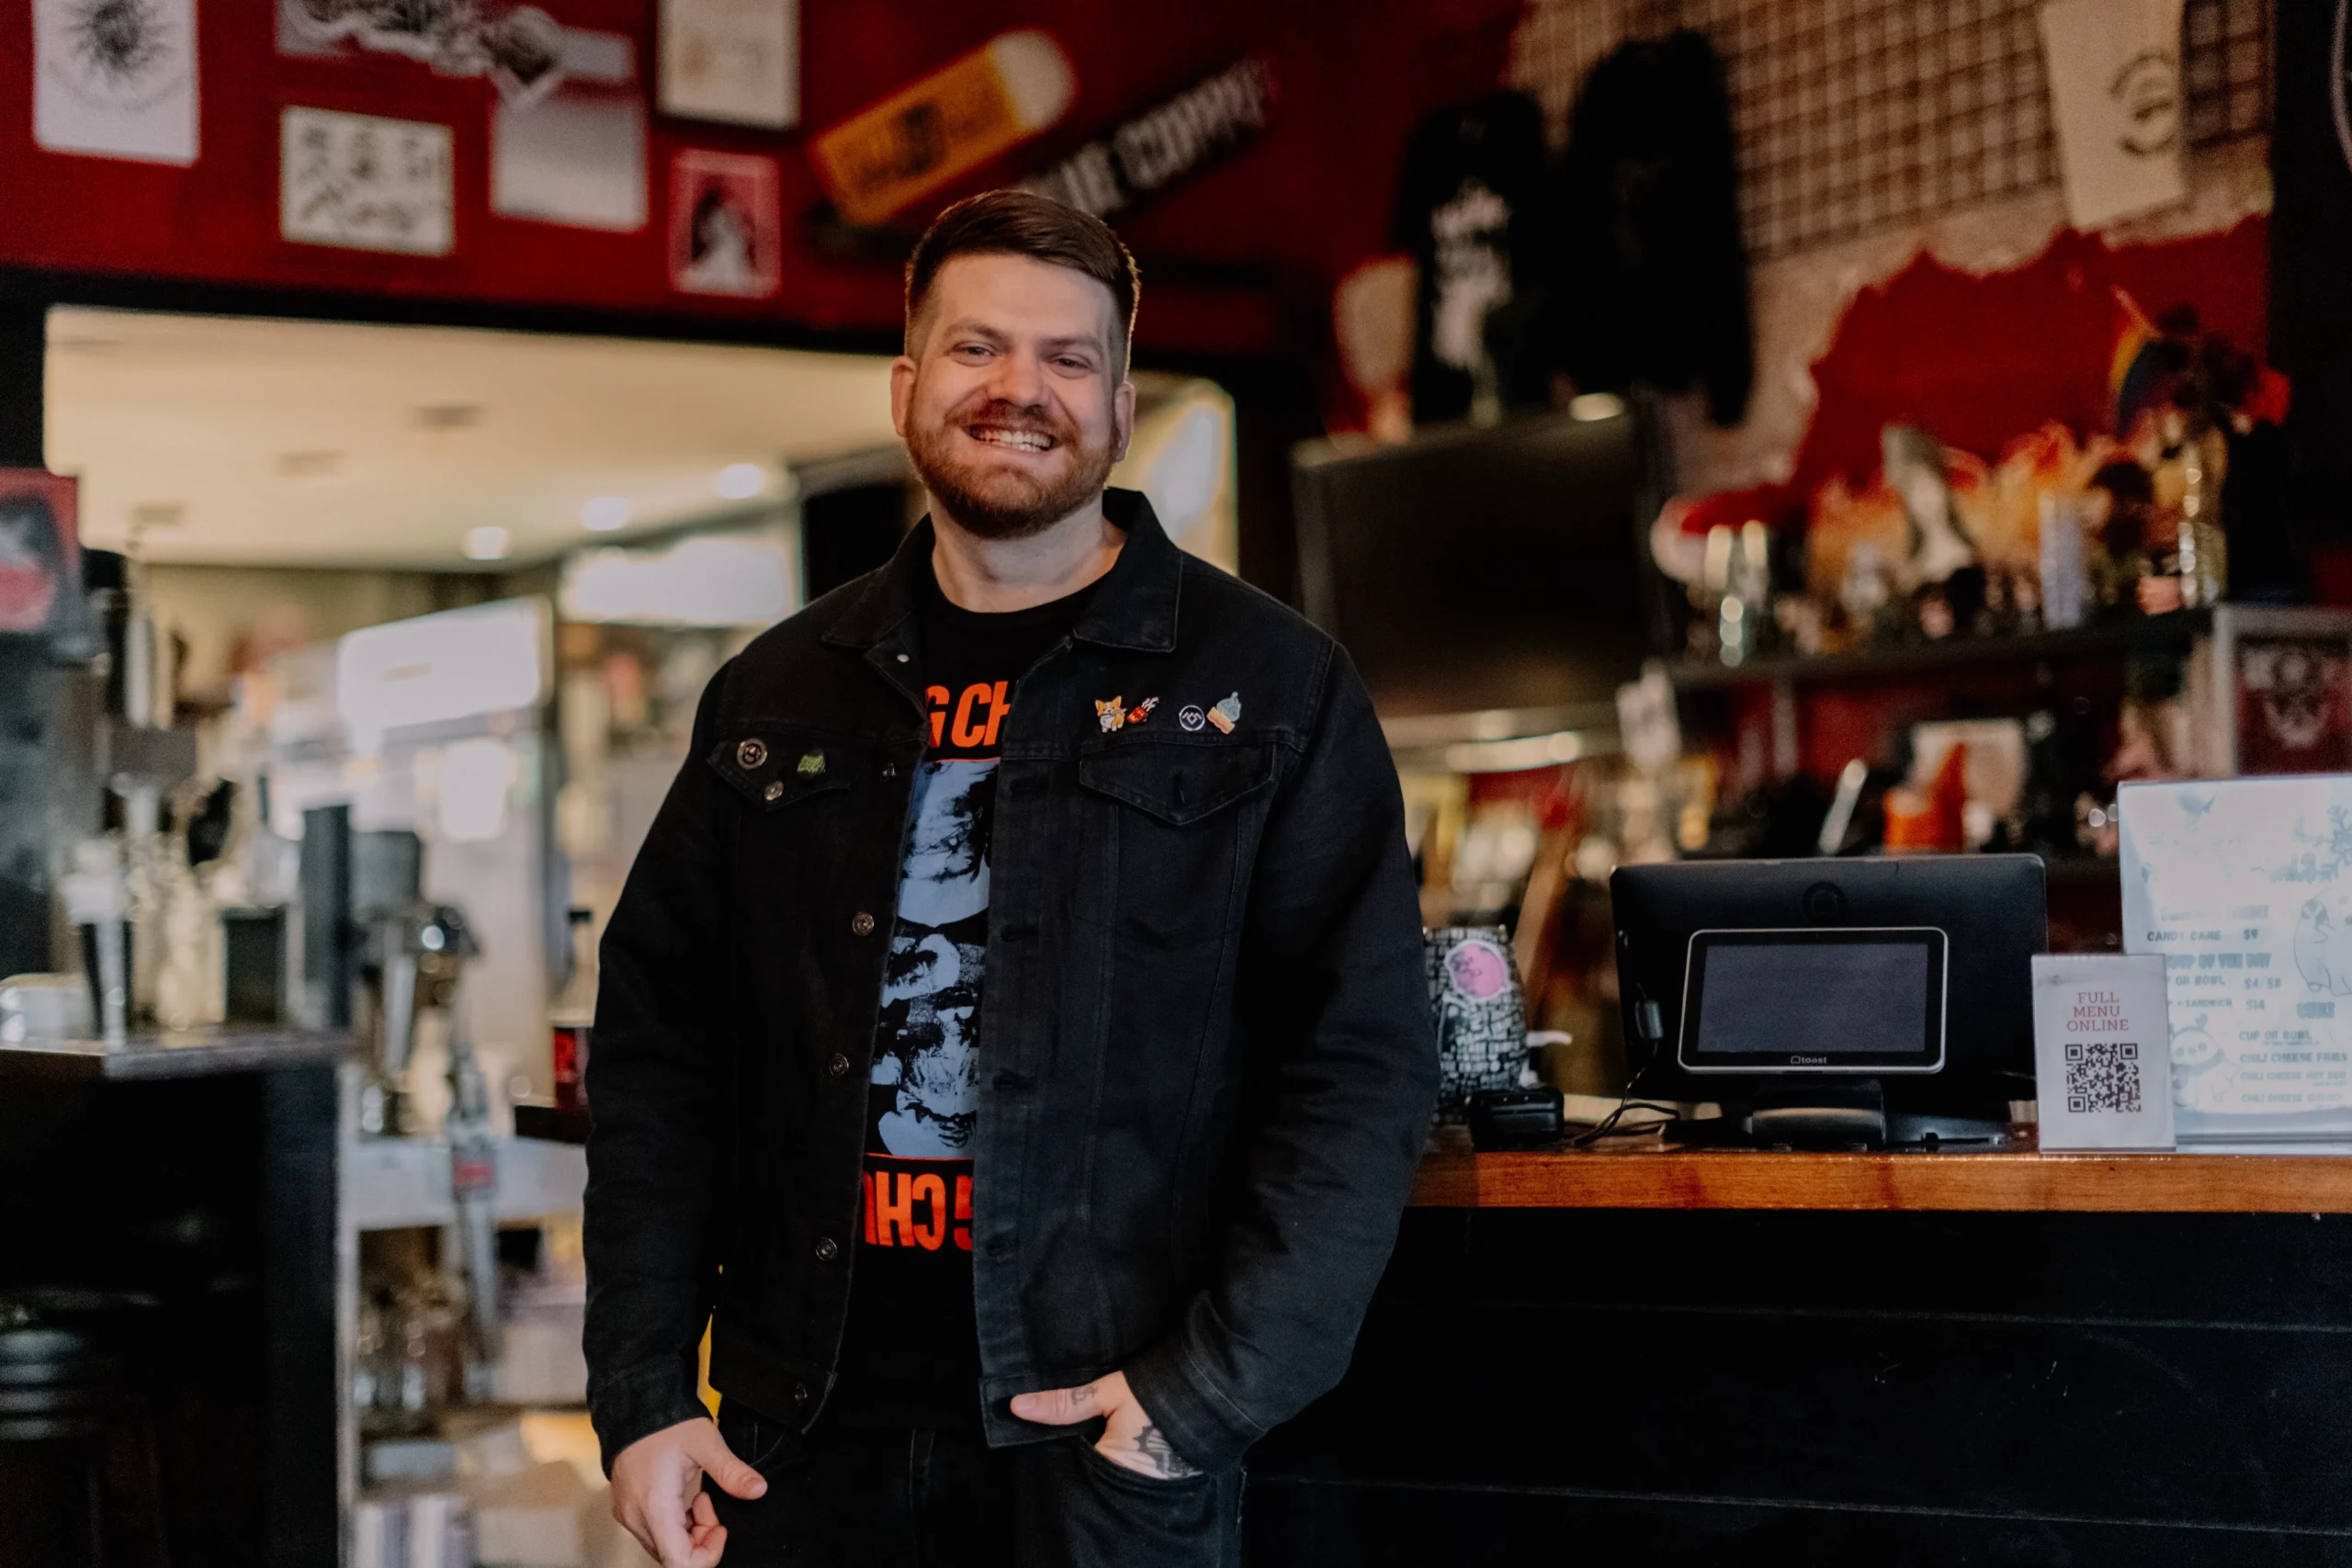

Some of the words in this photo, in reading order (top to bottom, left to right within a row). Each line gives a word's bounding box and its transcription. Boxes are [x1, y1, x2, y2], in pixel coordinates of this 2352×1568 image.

[2147, 931, 2185, 942] CANDY
[2190, 931, 2222, 941] CANE
[2244, 928, 2258, 941] $9
[2078, 991, 2120, 1004] FULL
[2186, 998, 2233, 1008] SANDWICH
[2074, 1005, 2120, 1018] MENU
[2066, 1019, 2129, 1032] ONLINE
[2239, 1031, 2259, 1041] CUP
[1801, 1056, 1828, 1065] toast
[2271, 1052, 2313, 1063] CHEESE
